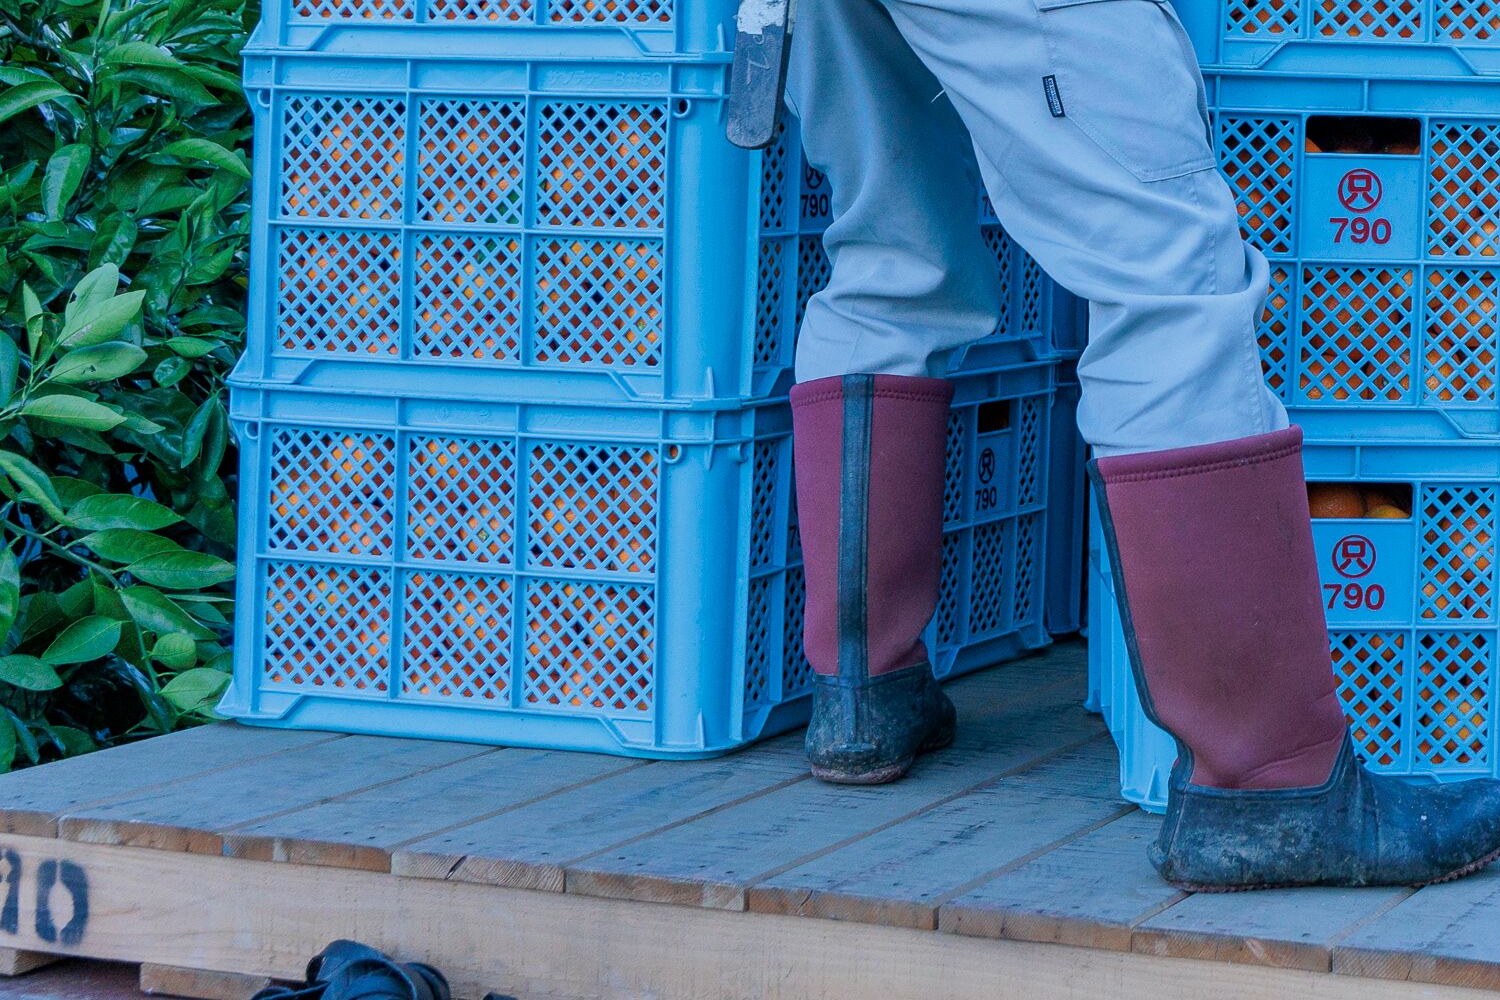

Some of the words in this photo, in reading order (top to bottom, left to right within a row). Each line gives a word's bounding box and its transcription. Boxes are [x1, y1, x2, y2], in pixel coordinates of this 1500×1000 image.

[800, 193, 829, 218] 790
[1329, 216, 1393, 245] 790
[975, 486, 997, 511] 790
[1323, 583, 1385, 613] 790
